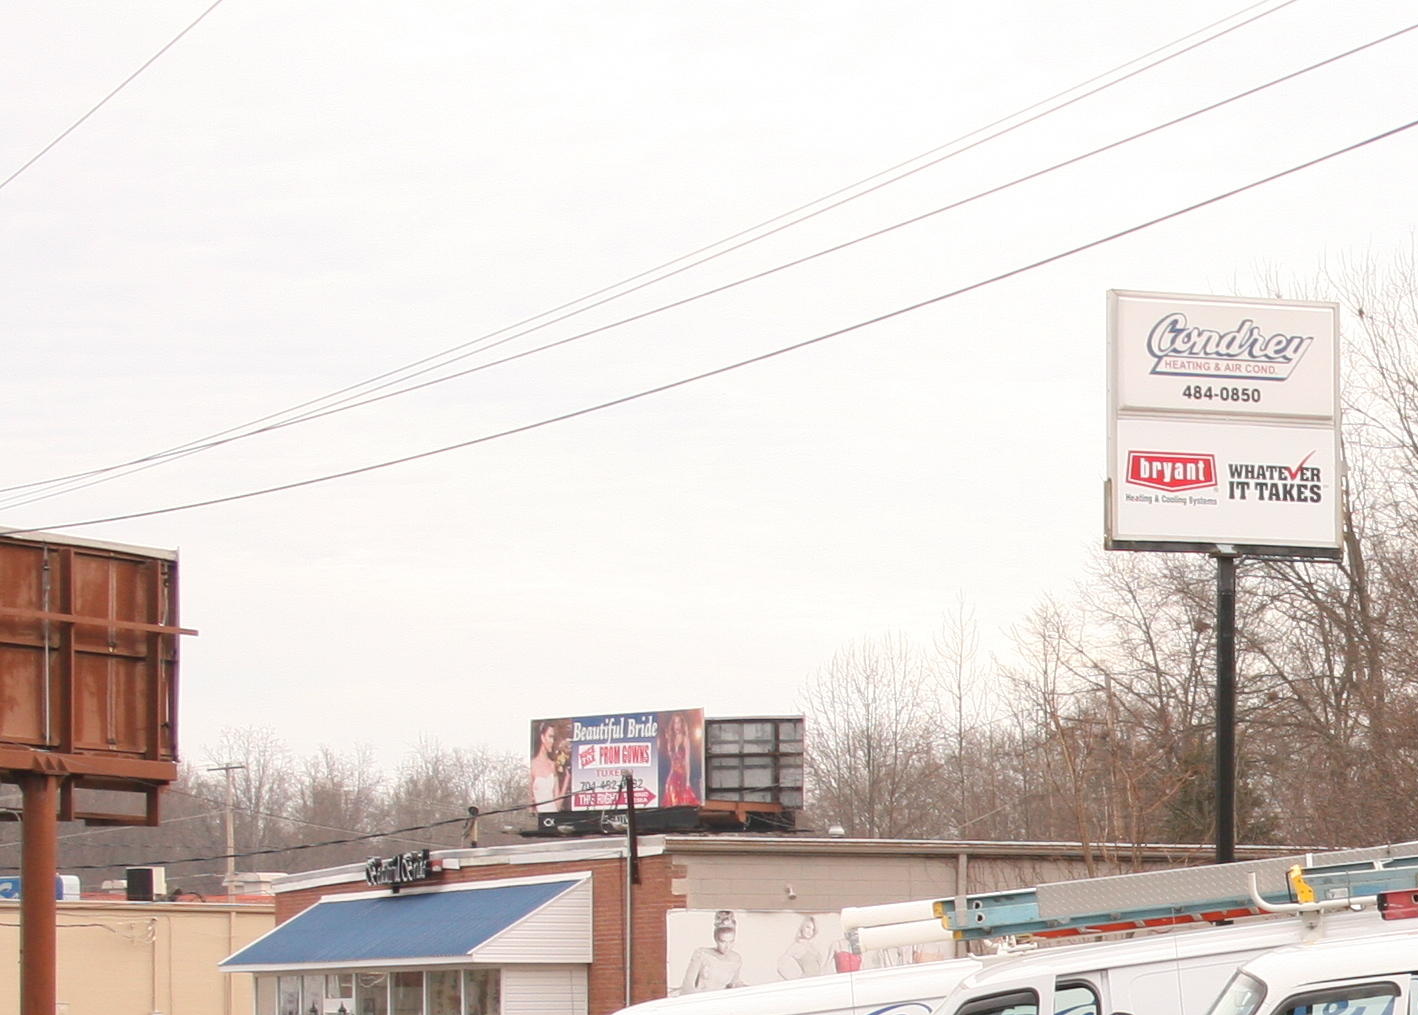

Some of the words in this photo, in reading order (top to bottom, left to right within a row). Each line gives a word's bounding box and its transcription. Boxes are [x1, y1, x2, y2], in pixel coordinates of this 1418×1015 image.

[1147, 312, 1314, 365] Condrey
[1164, 360, 1211, 371] HEATING
[1213, 361, 1222, 372] &
[1223, 363, 1243, 373] AIR
[1245, 364, 1278, 375] COND.
[1182, 385, 1262, 403] 484-0850
[1139, 457, 1206, 482] bryant
[1228, 462, 1322, 483] WHATEVER
[1125, 493, 1153, 504] Heating
[1154, 494, 1160, 503] &
[1161, 495, 1188, 506] Cooling
[1228, 481, 1250, 500] IT
[1254, 483, 1323, 503] TAKES
[573, 717, 625, 744] Beautiful
[626, 715, 658, 739] Bride
[600, 745, 621, 765] PROM
[622, 744, 650, 764] GOWNS
